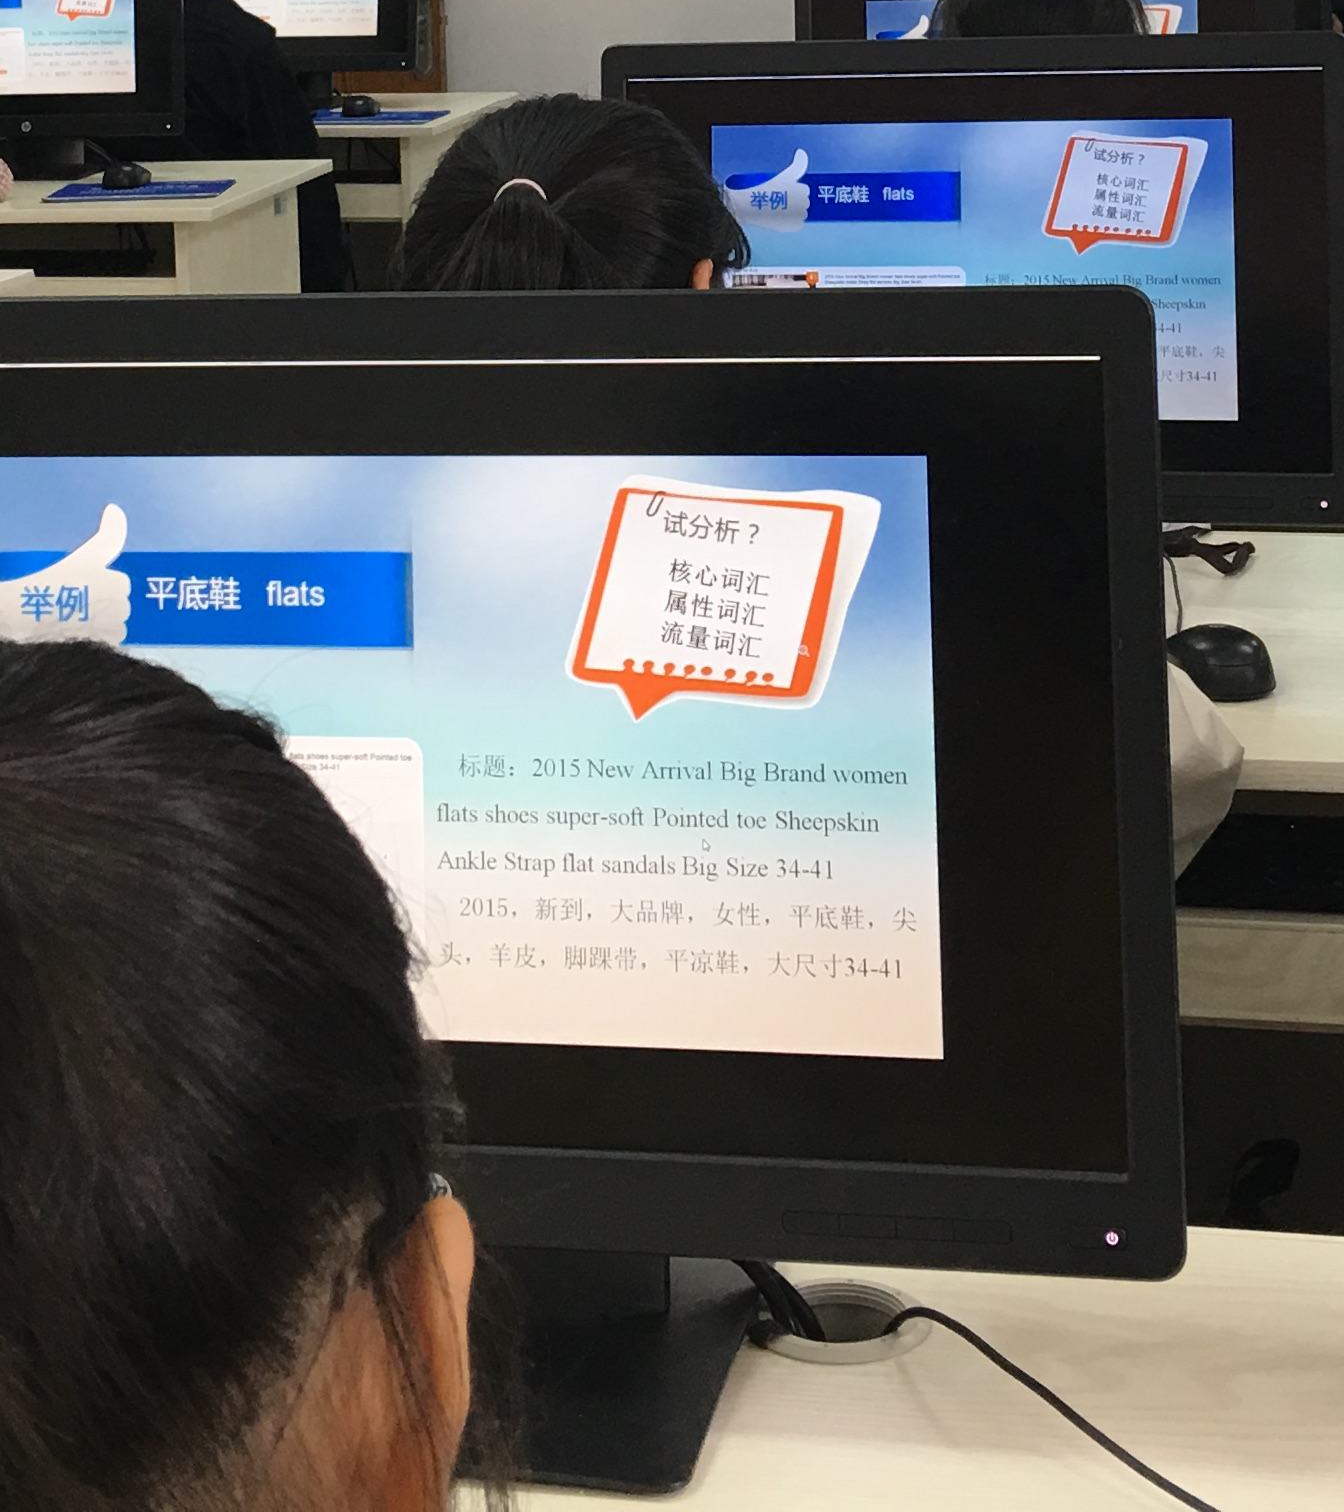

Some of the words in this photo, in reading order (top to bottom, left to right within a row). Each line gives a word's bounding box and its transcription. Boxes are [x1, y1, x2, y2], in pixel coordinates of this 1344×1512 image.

[818, 185, 870, 204] 平底鞋
[883, 186, 914, 201] flats
[1097, 173, 1149, 191] 核心词汇
[750, 191, 788, 210] 举例
[1094, 188, 1147, 207] 属性词汇
[1092, 204, 1146, 222] 流量词汇
[1053, 274, 1079, 285] New
[1123, 274, 1142, 287] Big
[1145, 274, 1178, 286] Brand
[1182, 276, 1221, 286] women
[1156, 323, 1181, 333] 4-41
[664, 510, 760, 544] 试分析？
[668, 558, 771, 597] 核心词汇
[20, 584, 89, 623] 举例
[145, 576, 241, 611] 平底鞋
[266, 580, 325, 607] flats
[664, 589, 767, 627] 属性词汇
[660, 621, 763, 658] 流量词汇
[587, 760, 633, 780] New
[642, 761, 712, 781] Arrival
[721, 761, 756, 787] Big
[764, 762, 826, 784] Brand
[833, 767, 909, 786] women
[436, 802, 478, 824] flats
[485, 804, 539, 825] shoes
[546, 806, 645, 831] super-soft
[653, 808, 730, 830] Pointed
[737, 811, 767, 830] toe
[775, 810, 880, 835] Sheepskin
[436, 850, 497, 872] Ankle
[503, 851, 556, 878] Strap
[562, 852, 595, 874] flat
[602, 854, 676, 876] sandals
[682, 856, 719, 882] Big
[726, 856, 769, 879] Size
[775, 857, 834, 880] 34-41
